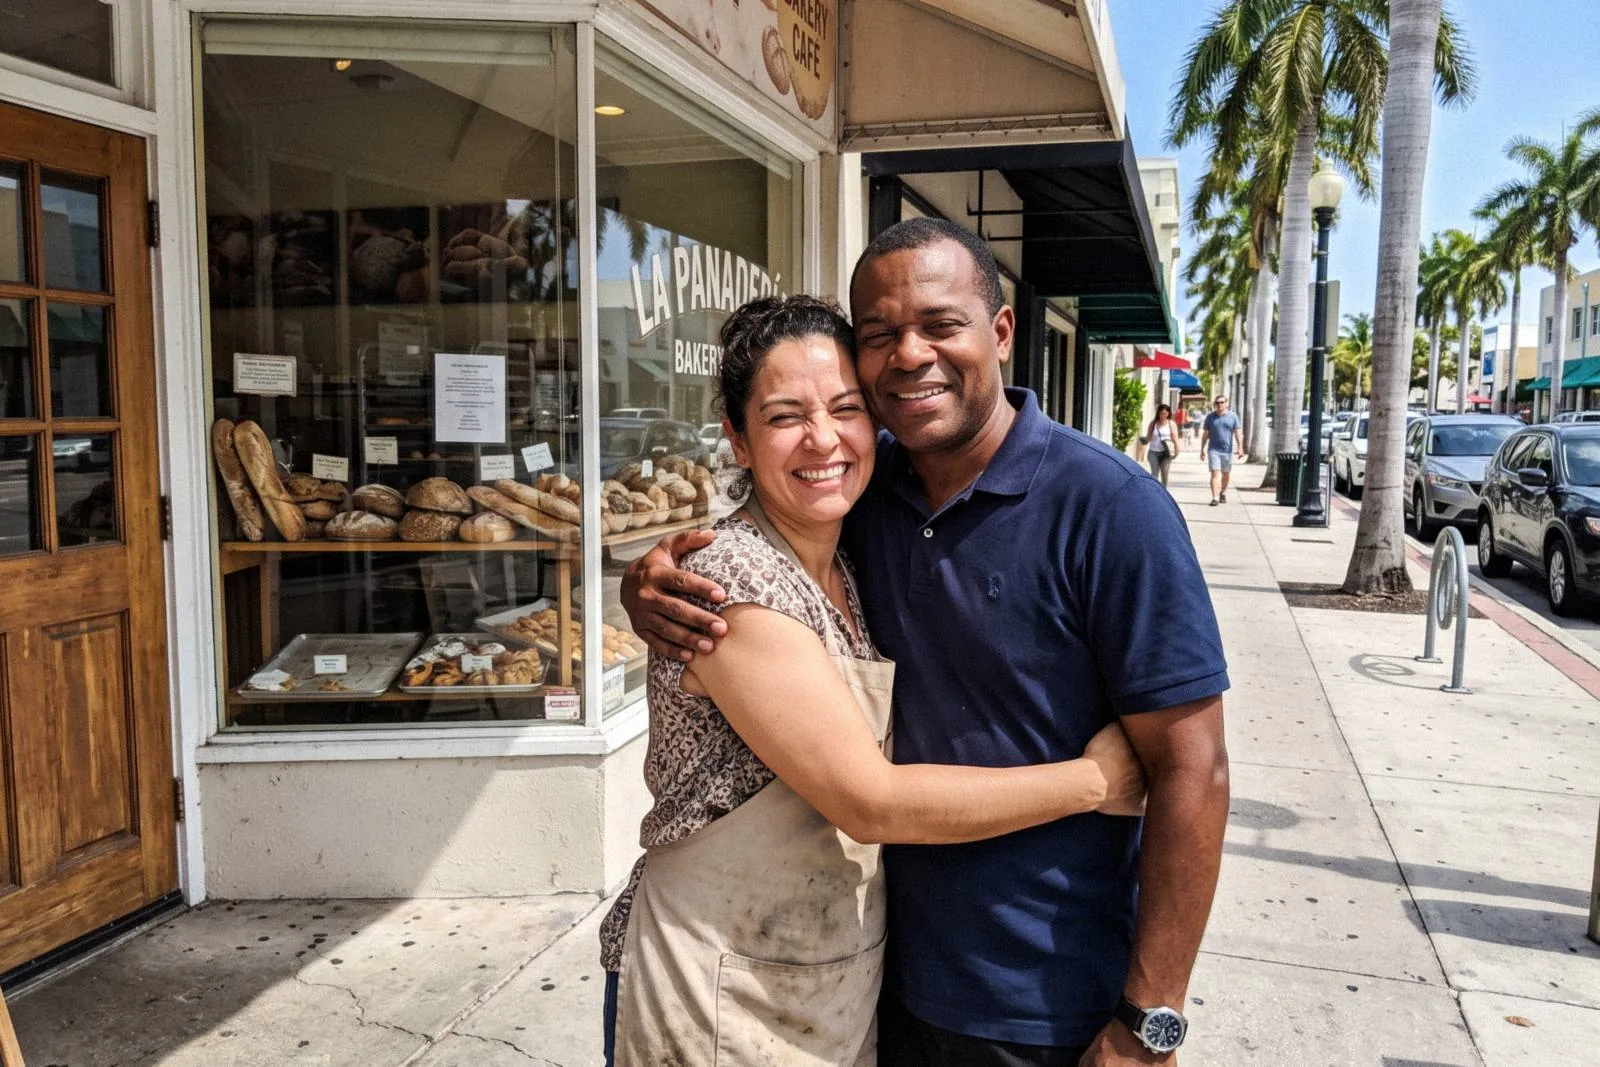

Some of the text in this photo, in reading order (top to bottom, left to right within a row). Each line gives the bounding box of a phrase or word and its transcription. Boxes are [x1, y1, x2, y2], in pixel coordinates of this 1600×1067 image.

[785, 0, 828, 40] KERY
[632, 245, 787, 337] LA PANADER
[675, 339, 724, 376] BAKERY
